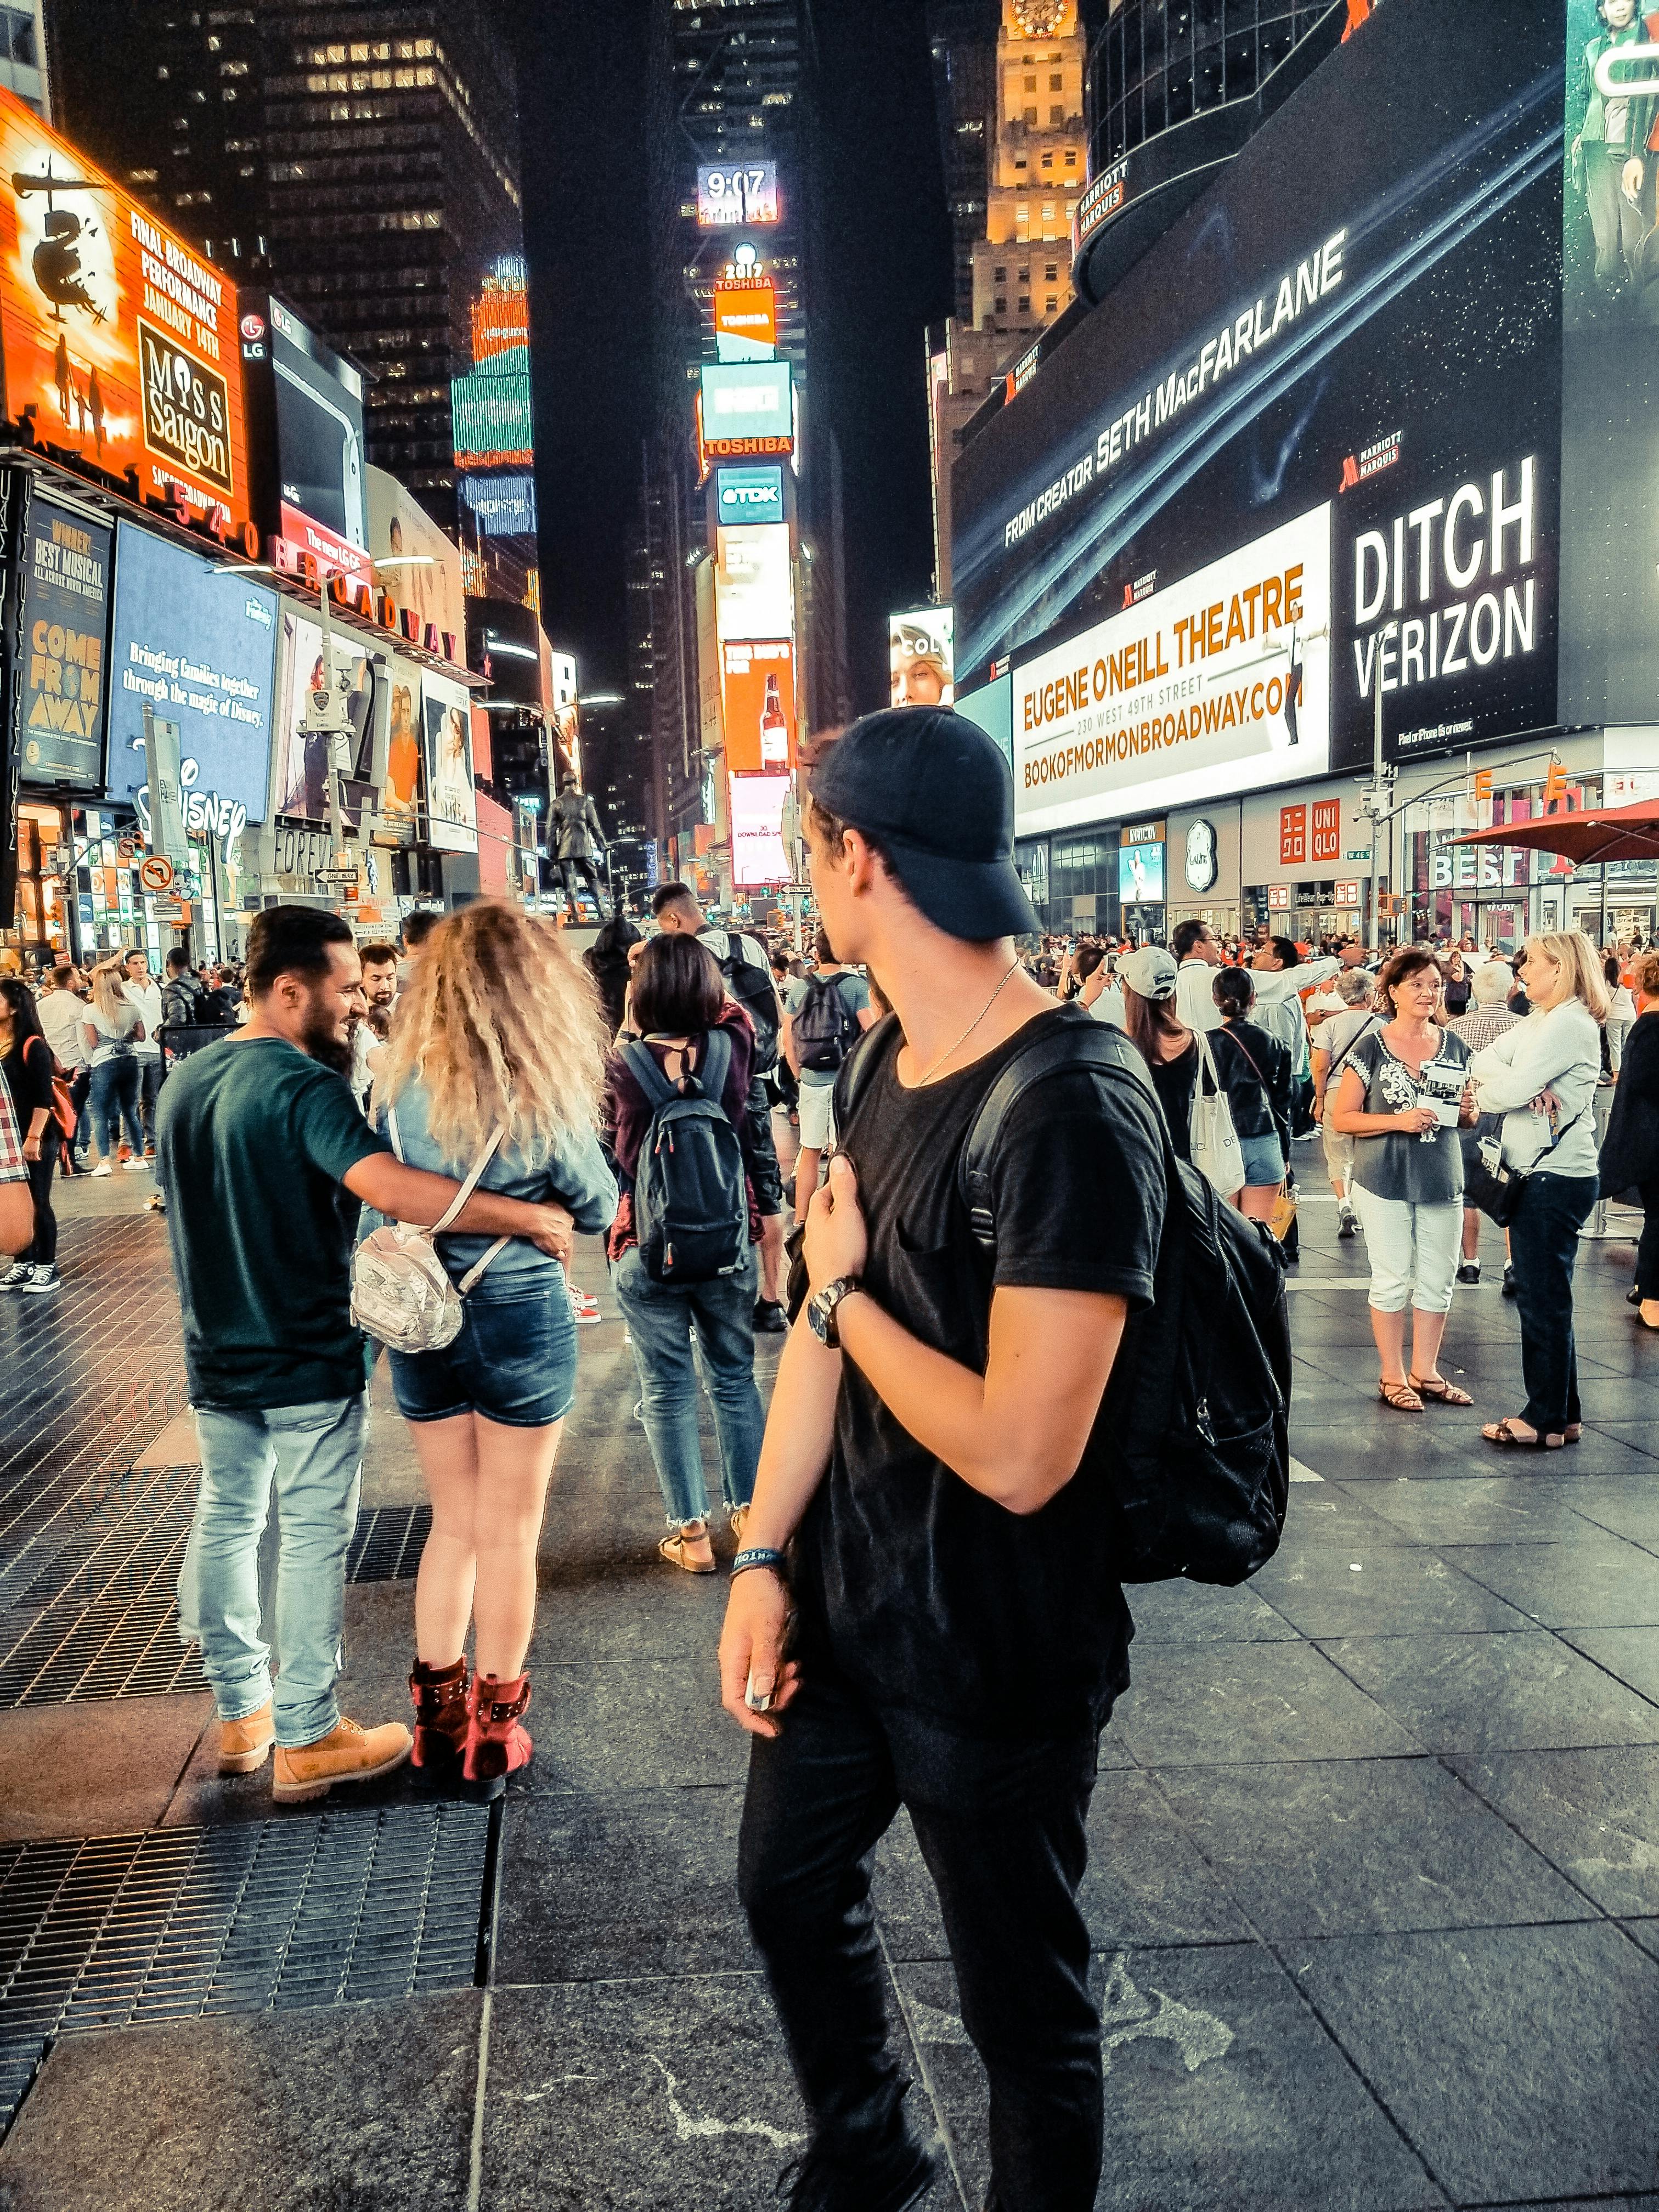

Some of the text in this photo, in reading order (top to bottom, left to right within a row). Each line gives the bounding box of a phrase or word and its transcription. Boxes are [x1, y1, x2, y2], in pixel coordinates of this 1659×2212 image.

[708, 170, 765, 198] 9:07
[1081, 160, 1128, 217] MARRIOTT
[1081, 188, 1120, 236] MARQUIS
[131, 211, 222, 307] FINAL BROADWAY
[715, 278, 772, 291] TOSHIBA
[725, 262, 763, 280] 2017
[141, 250, 218, 332] PERFORMANCE
[144, 283, 219, 360] JANUARY 14TH
[243, 342, 264, 358] LG
[149, 387, 228, 478] Saigon
[704, 437, 793, 455] TOSHIBA
[1096, 392, 1152, 473] SETH
[1360, 430, 1403, 462] MARRIOTT
[1360, 448, 1396, 478] MARQUIS
[735, 486, 779, 504] TDK
[1005, 454, 1093, 548] FROM CREATOR
[35, 537, 103, 588] BEST MUSICAL
[306, 526, 321, 552] The
[322, 539, 338, 561] new
[338, 545, 349, 566] LG
[1355, 455, 1534, 625] DITCH
[33, 565, 44, 580] ALL
[275, 535, 456, 661] BROADWAY
[32, 619, 101, 670] COME
[1024, 562, 1304, 731] EUGENE O'NEILL THEATRE
[1353, 579, 1534, 698] VERIZON
[31, 654, 100, 708] FROM
[123, 667, 168, 702] through
[170, 682, 188, 706] the
[189, 693, 219, 715] magic
[219, 697, 232, 717] of
[129, 641, 259, 701] Bringing families together
[28, 692, 98, 738] AWAY
[1077, 674, 1203, 735] 230 WEST 49TH STREET
[1314, 807, 1336, 830] UNI
[1314, 832, 1337, 857] QLO
